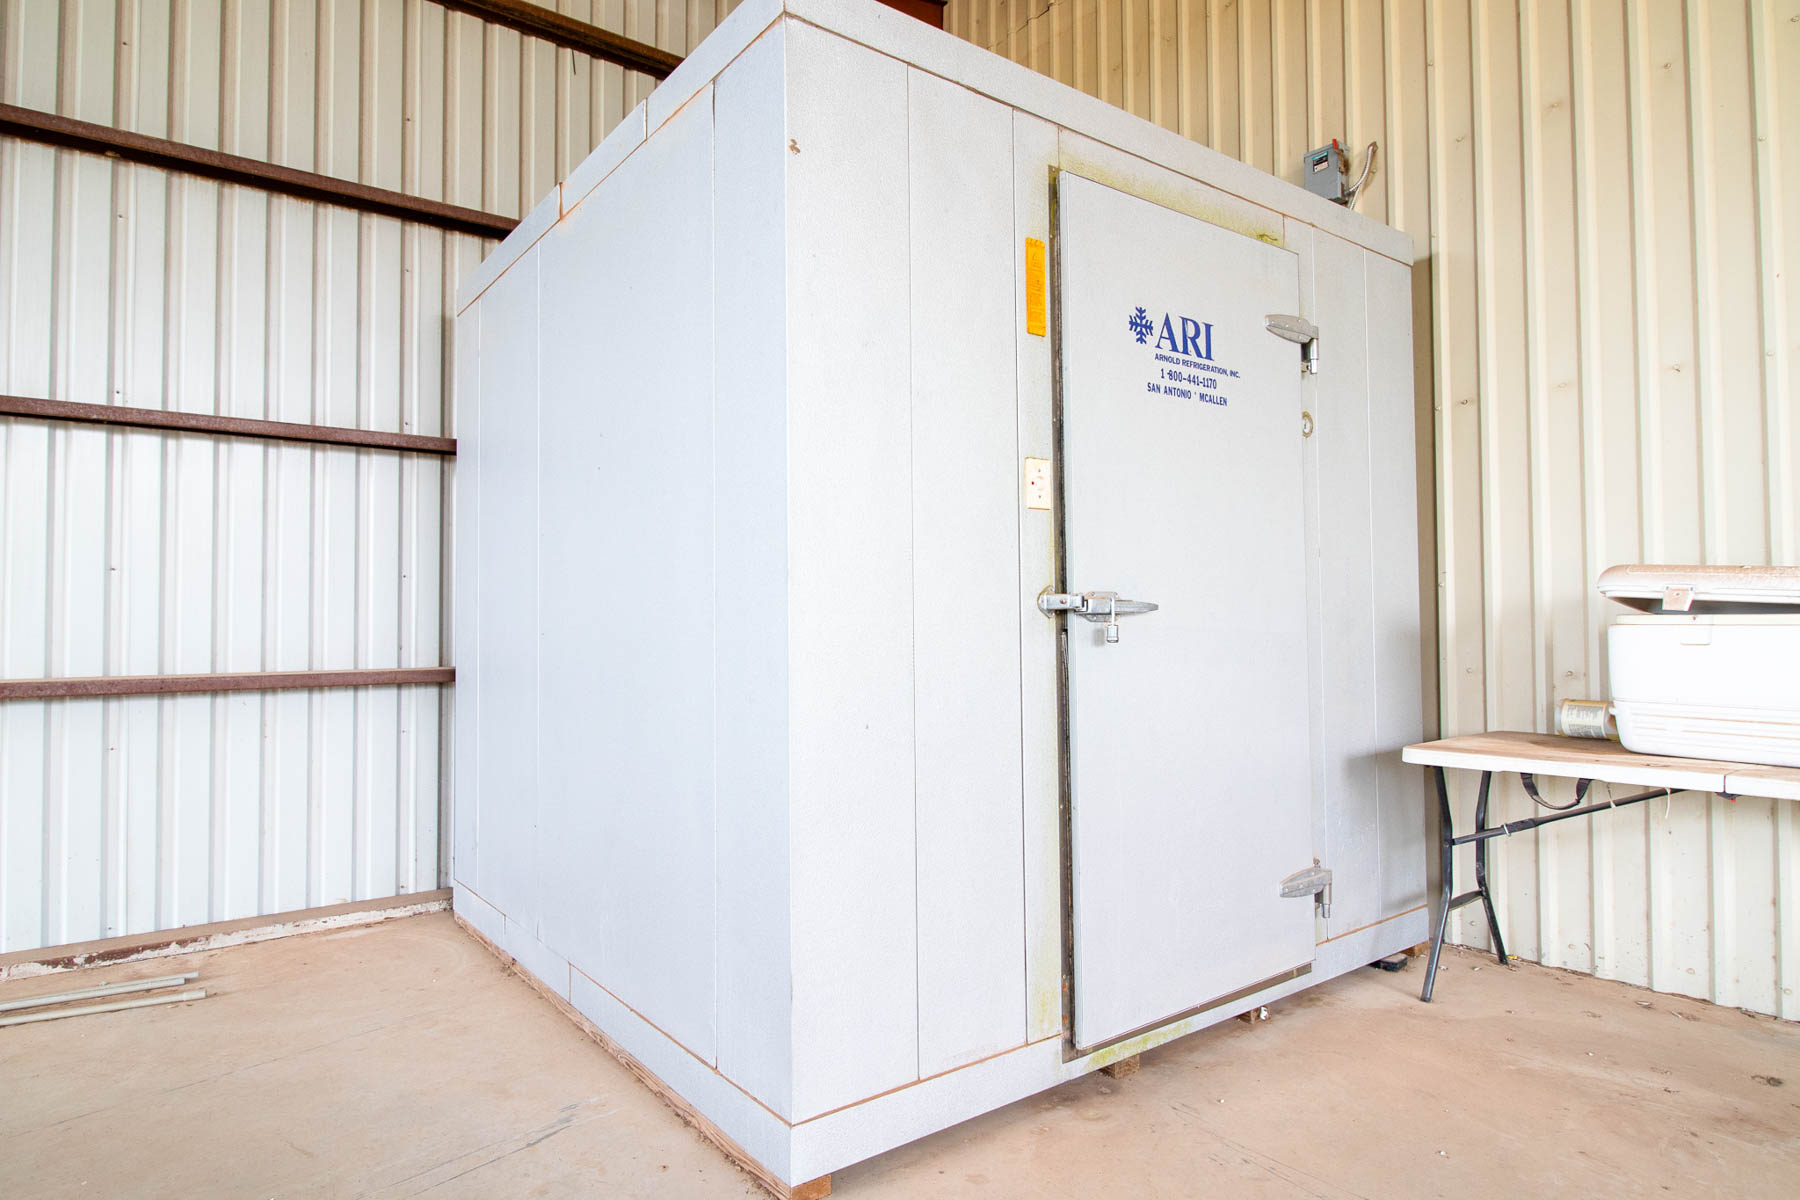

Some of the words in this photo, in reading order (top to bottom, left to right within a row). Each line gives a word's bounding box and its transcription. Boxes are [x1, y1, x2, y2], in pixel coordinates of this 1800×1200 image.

[1155, 312, 1215, 361] ARI
[1154, 353, 1181, 365] ARNOLD
[1181, 359, 1228, 377] REFRIGERATION,
[1229, 369, 1241, 379] INC.
[1147, 382, 1161, 394] SAN
[1163, 385, 1192, 399] ANTONIO
[1199, 392, 1228, 406] MCALLEN
